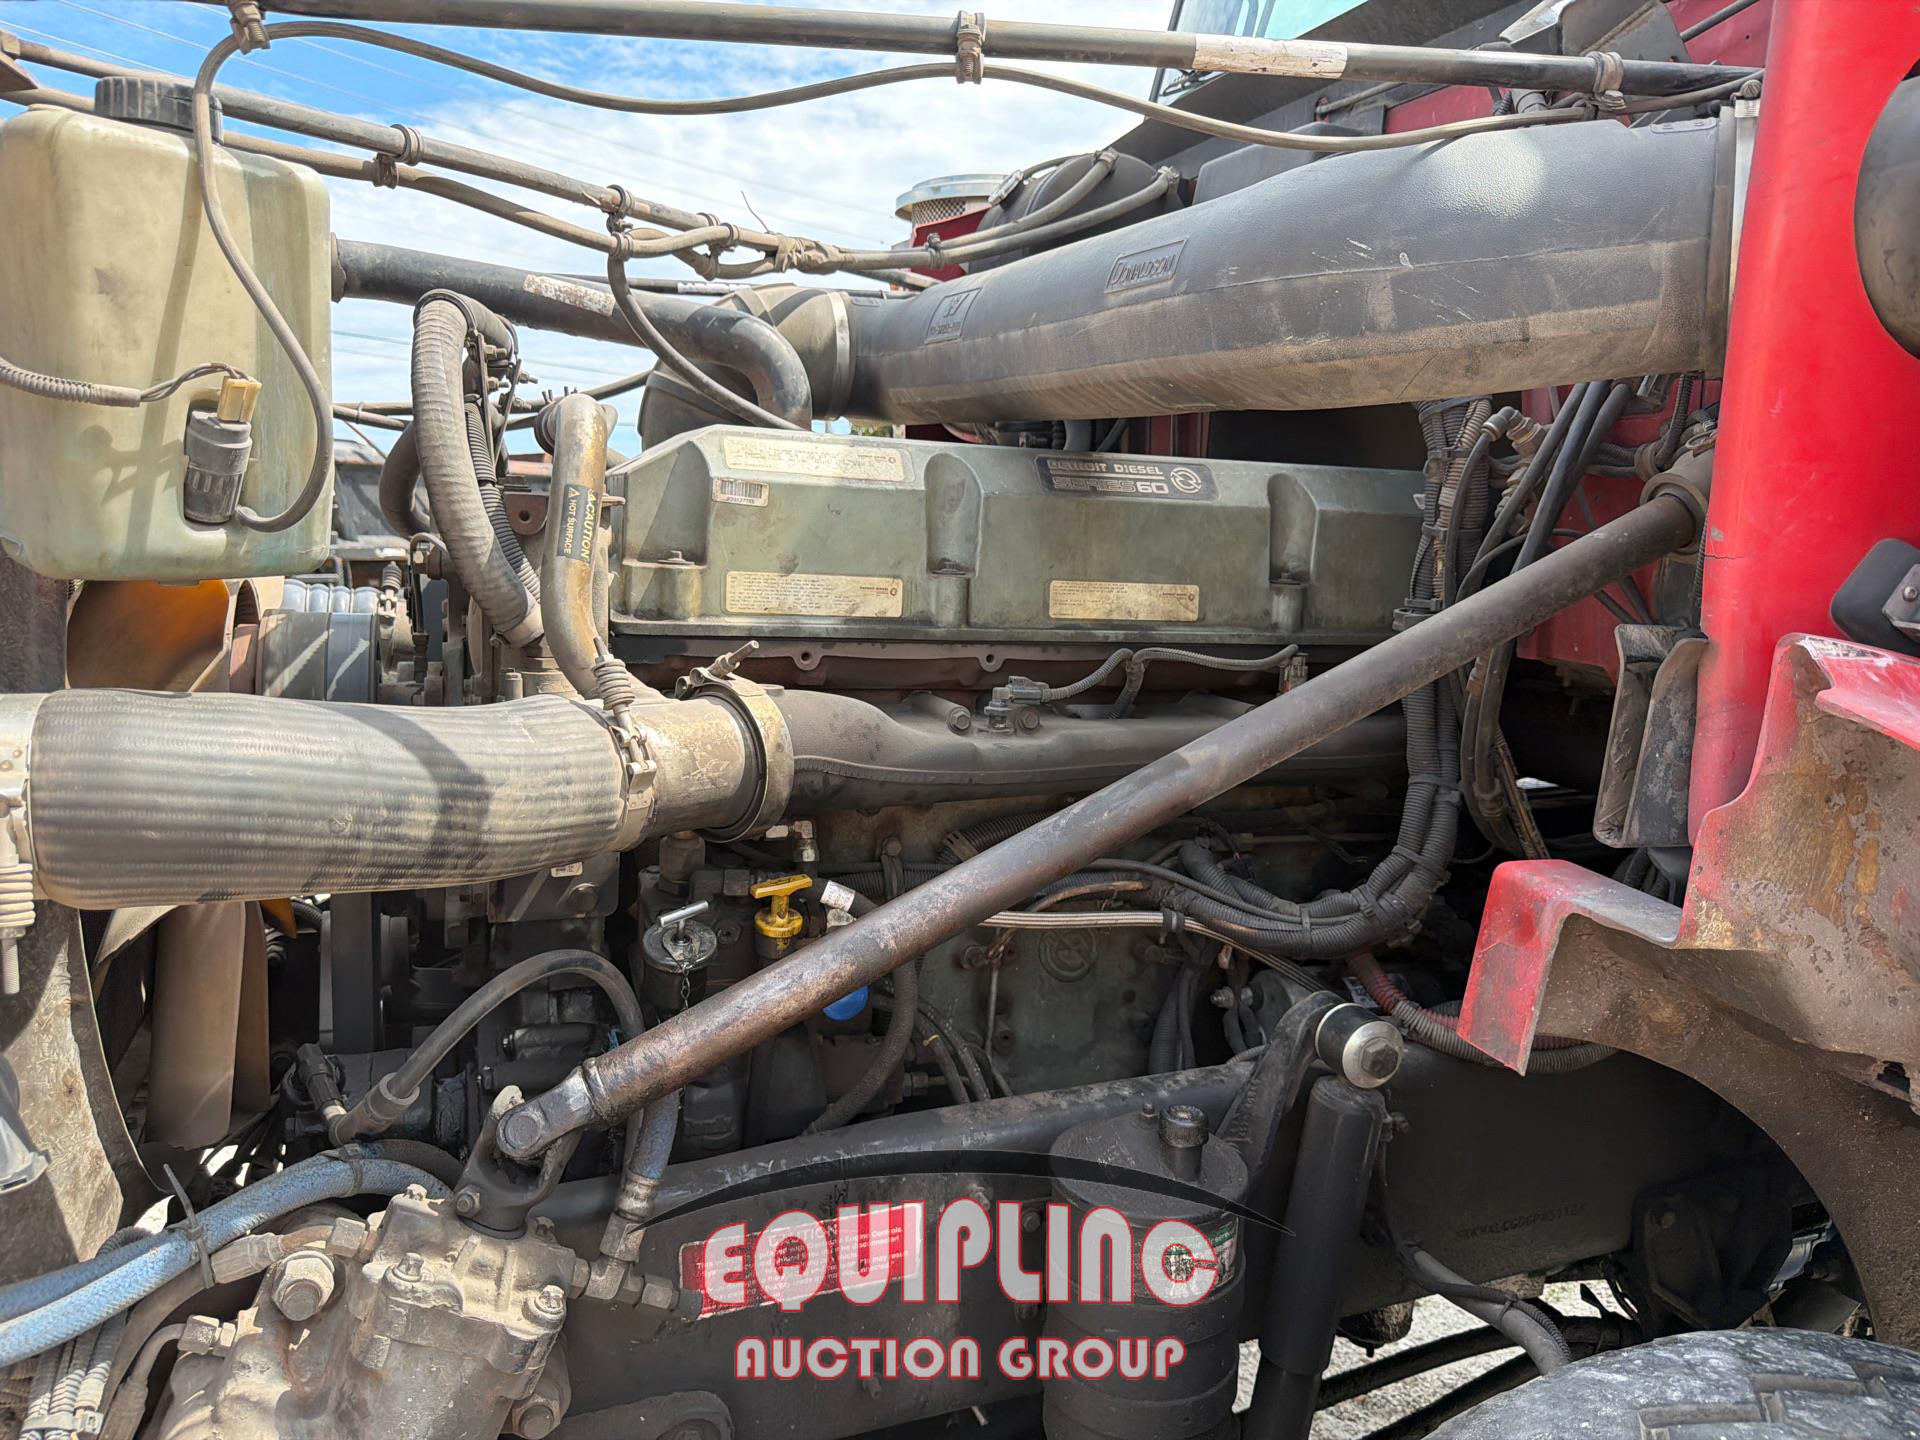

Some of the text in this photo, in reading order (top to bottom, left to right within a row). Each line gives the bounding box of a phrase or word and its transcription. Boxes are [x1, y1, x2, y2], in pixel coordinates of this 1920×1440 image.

[1114, 463, 1164, 475] DIESEL
[1136, 481, 1169, 495] 60
[563, 499, 577, 555] HOT SURFACE
[580, 502, 596, 559] CAUTION
